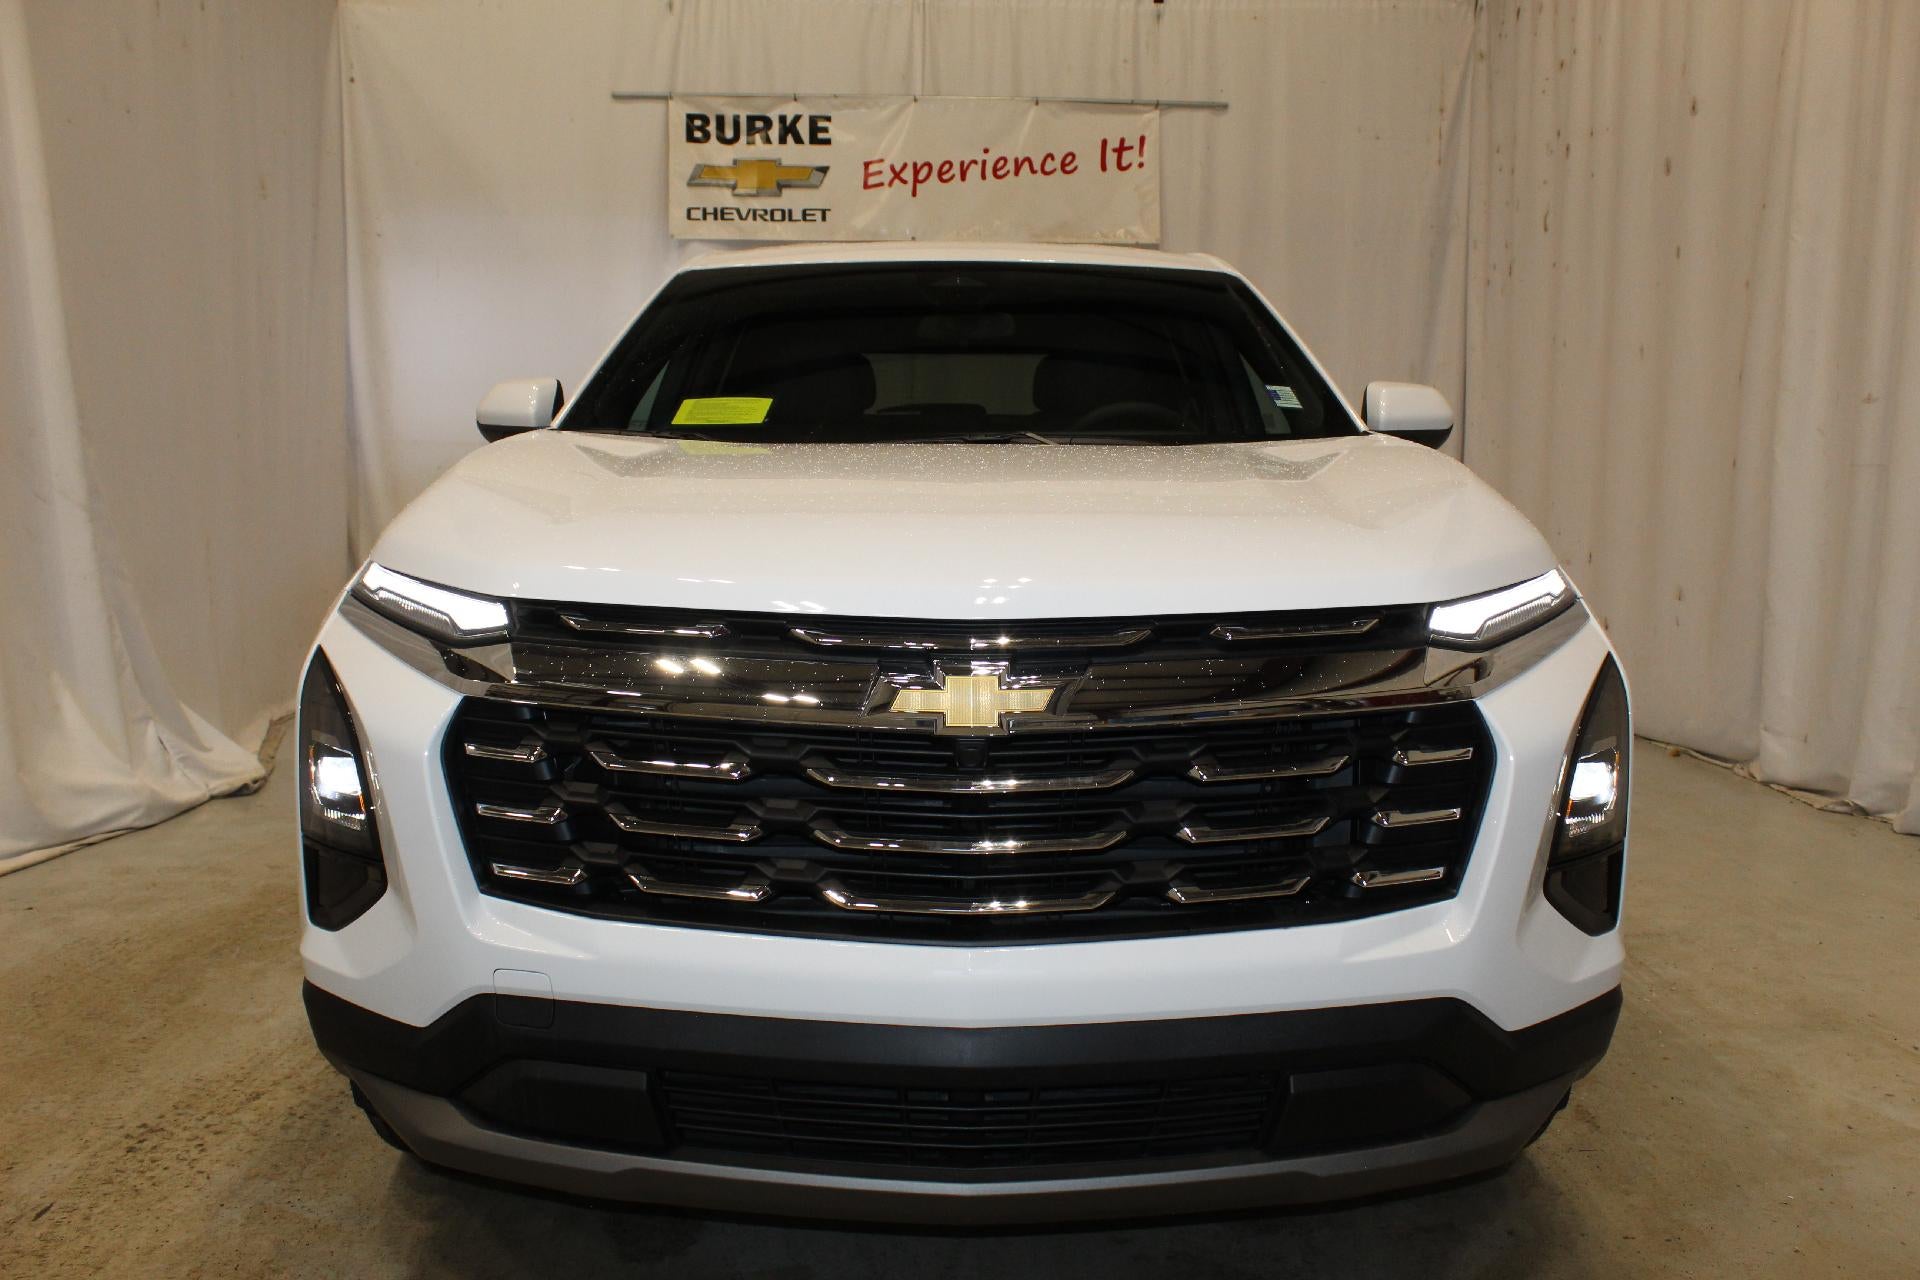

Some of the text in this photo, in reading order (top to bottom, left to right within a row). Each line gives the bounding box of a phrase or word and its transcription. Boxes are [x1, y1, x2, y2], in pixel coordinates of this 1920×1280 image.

[685, 113, 832, 145] BURKE
[862, 134, 1146, 197] Experience It!
[686, 206, 831, 223] CHEVROLET
